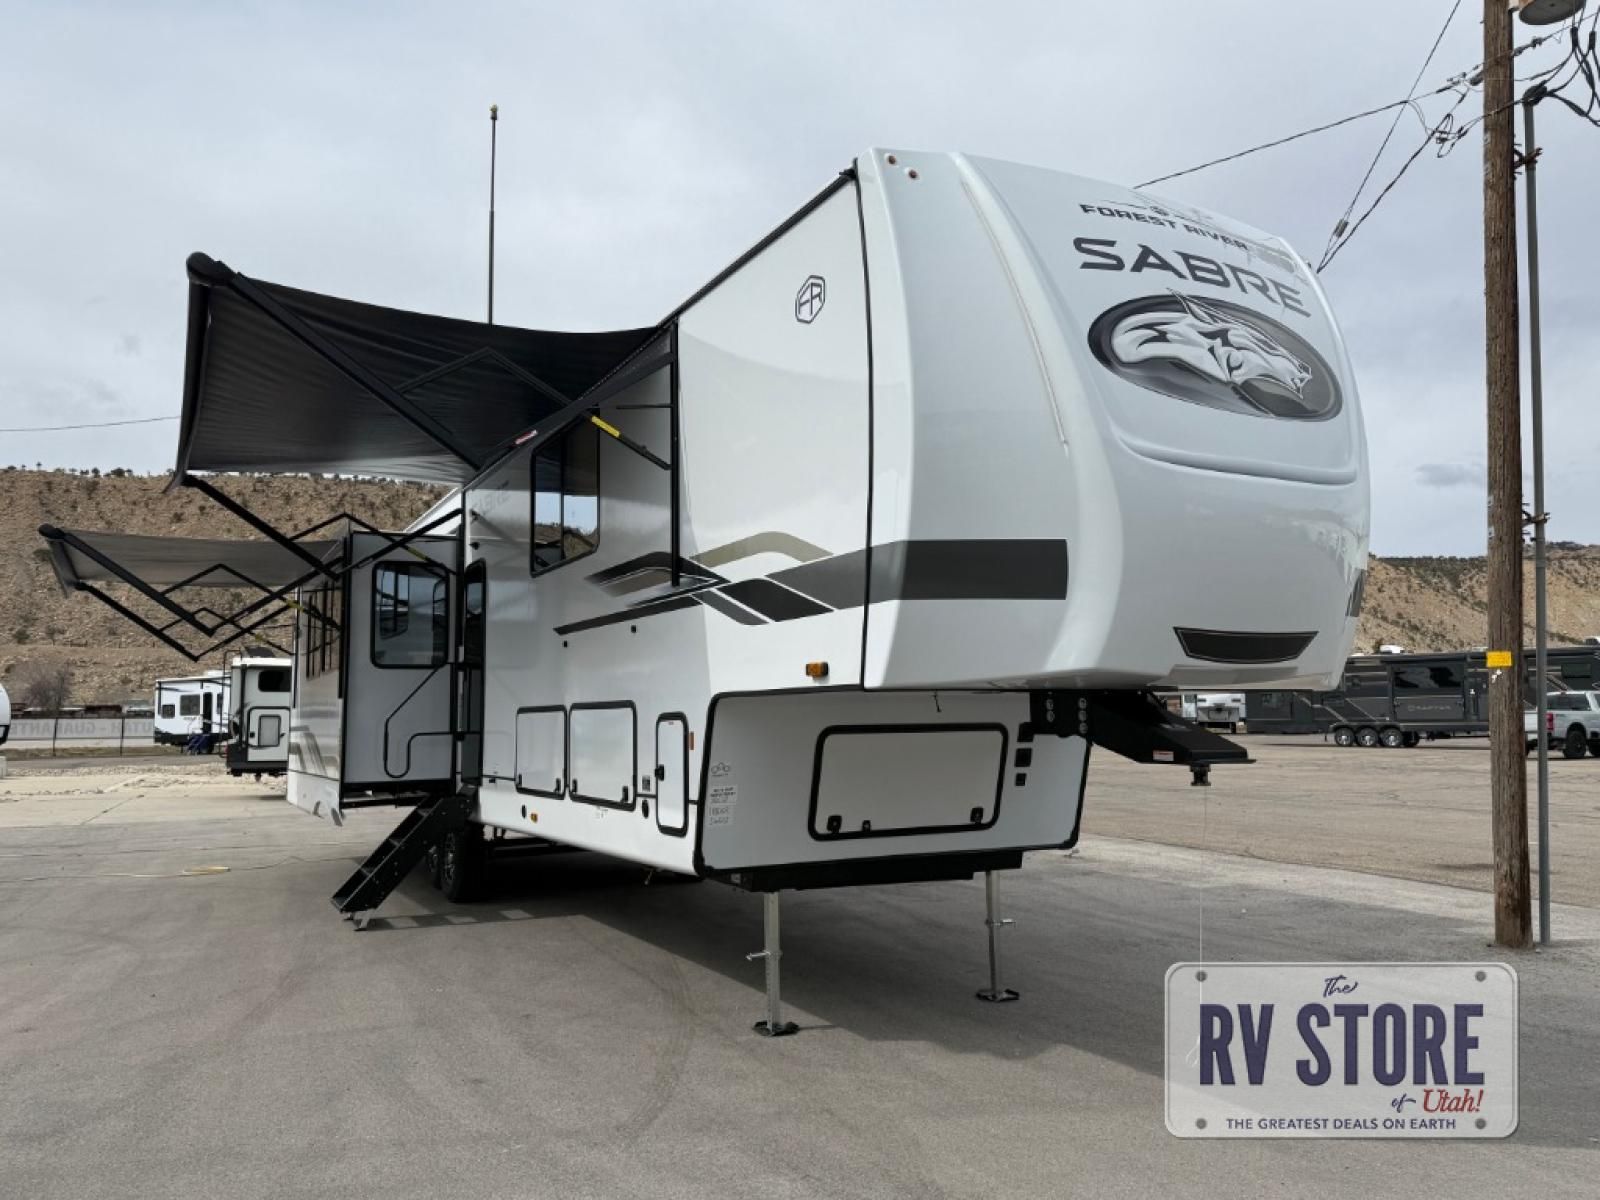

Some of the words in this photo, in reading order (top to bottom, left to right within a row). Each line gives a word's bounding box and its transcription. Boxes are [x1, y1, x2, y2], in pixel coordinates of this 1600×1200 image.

[1079, 204, 1177, 229] FOREST
[1183, 224, 1249, 251] RIVER
[1073, 237, 1312, 318] SABRE
